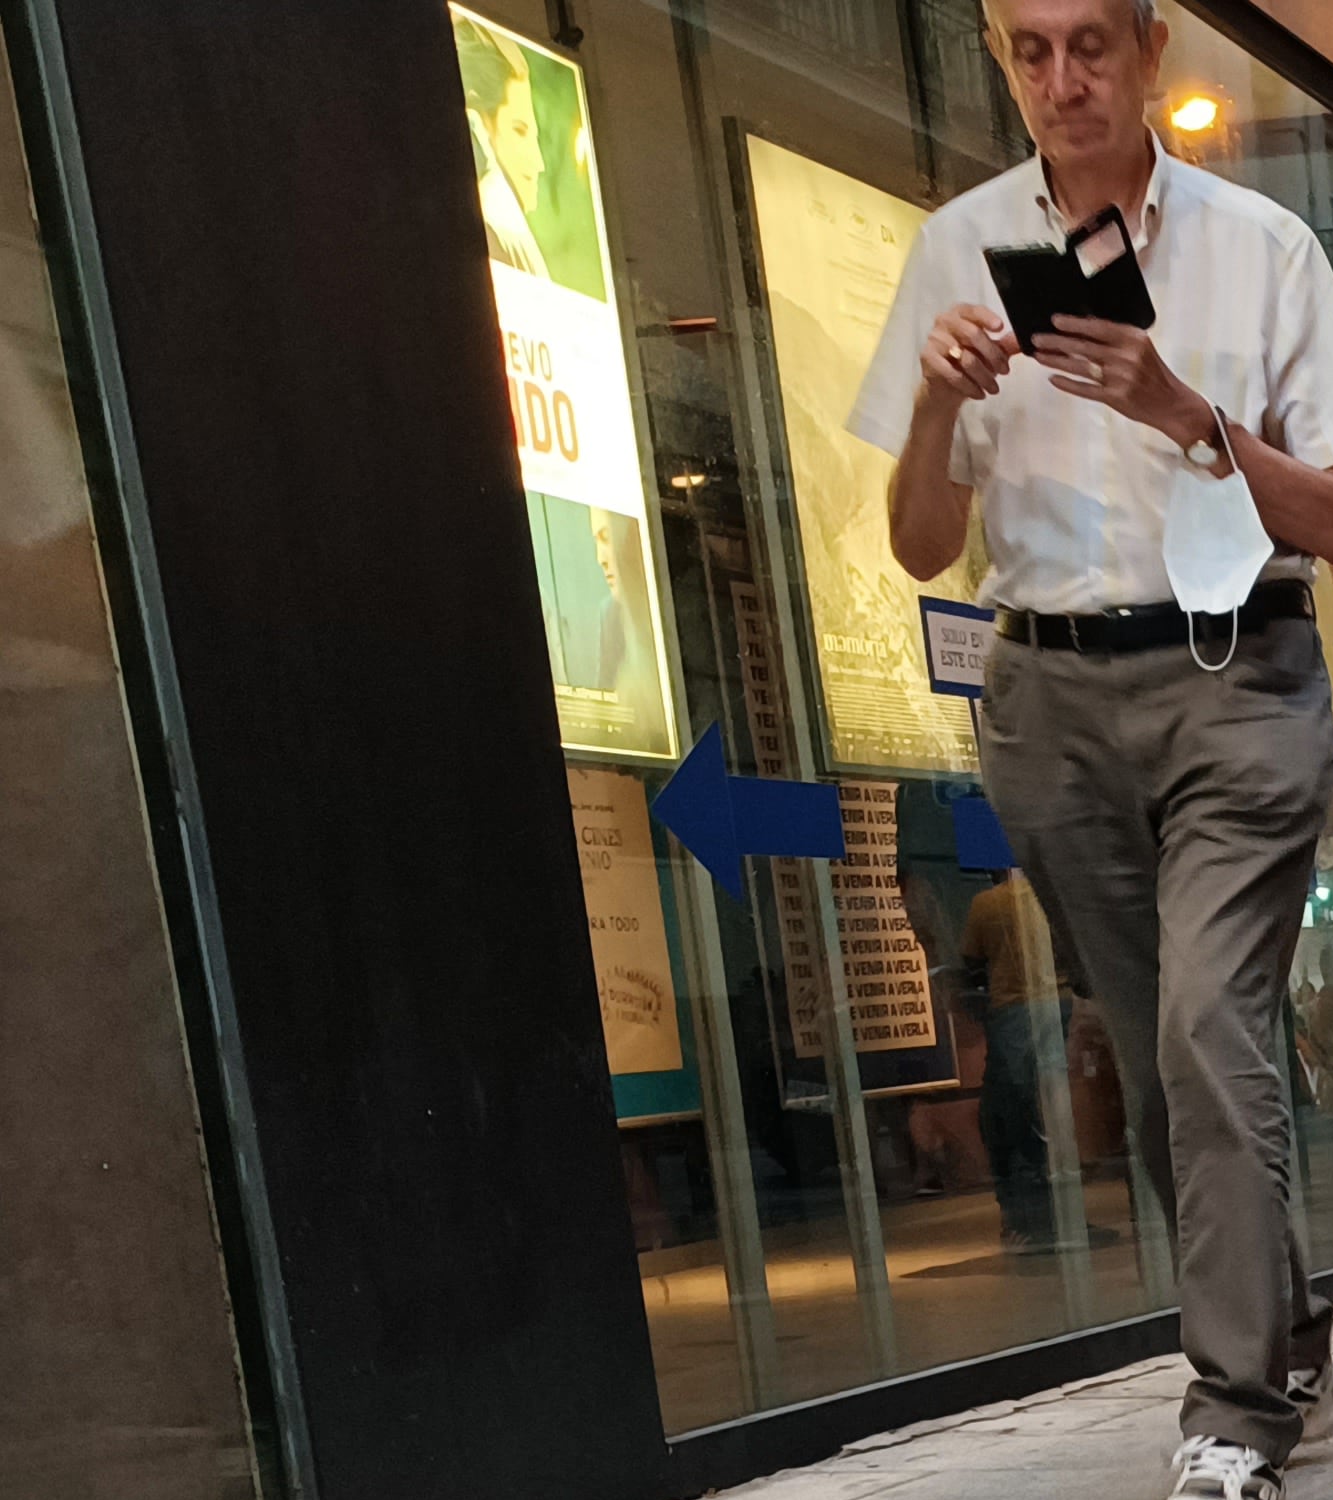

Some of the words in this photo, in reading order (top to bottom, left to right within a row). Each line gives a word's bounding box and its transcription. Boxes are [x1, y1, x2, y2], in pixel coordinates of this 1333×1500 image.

[507, 331, 553, 382] EVO
[940, 649, 965, 668] ESTE
[840, 787, 861, 802] ENIR
[872, 789, 897, 804] VERL
[842, 809, 865, 823] ENIR
[845, 830, 868, 845] ENIR
[878, 833, 897, 846] VER
[580, 850, 612, 870] NIO
[589, 916, 606, 930] RA
[609, 915, 640, 932] TODO
[849, 917, 879, 932] VENIR
[881, 918, 888, 932] A
[852, 939, 882, 954] VENIR
[885, 939, 890, 953] A
[854, 961, 884, 976] VENIR
[886, 960, 893, 975] A
[894, 959, 921, 975] VERLA
[888, 982, 895, 996] A
[896, 981, 925, 996] VERLA
[891, 1004, 897, 1017] A
[898, 1002, 927, 1017] VERLA
[893, 1025, 900, 1038] A
